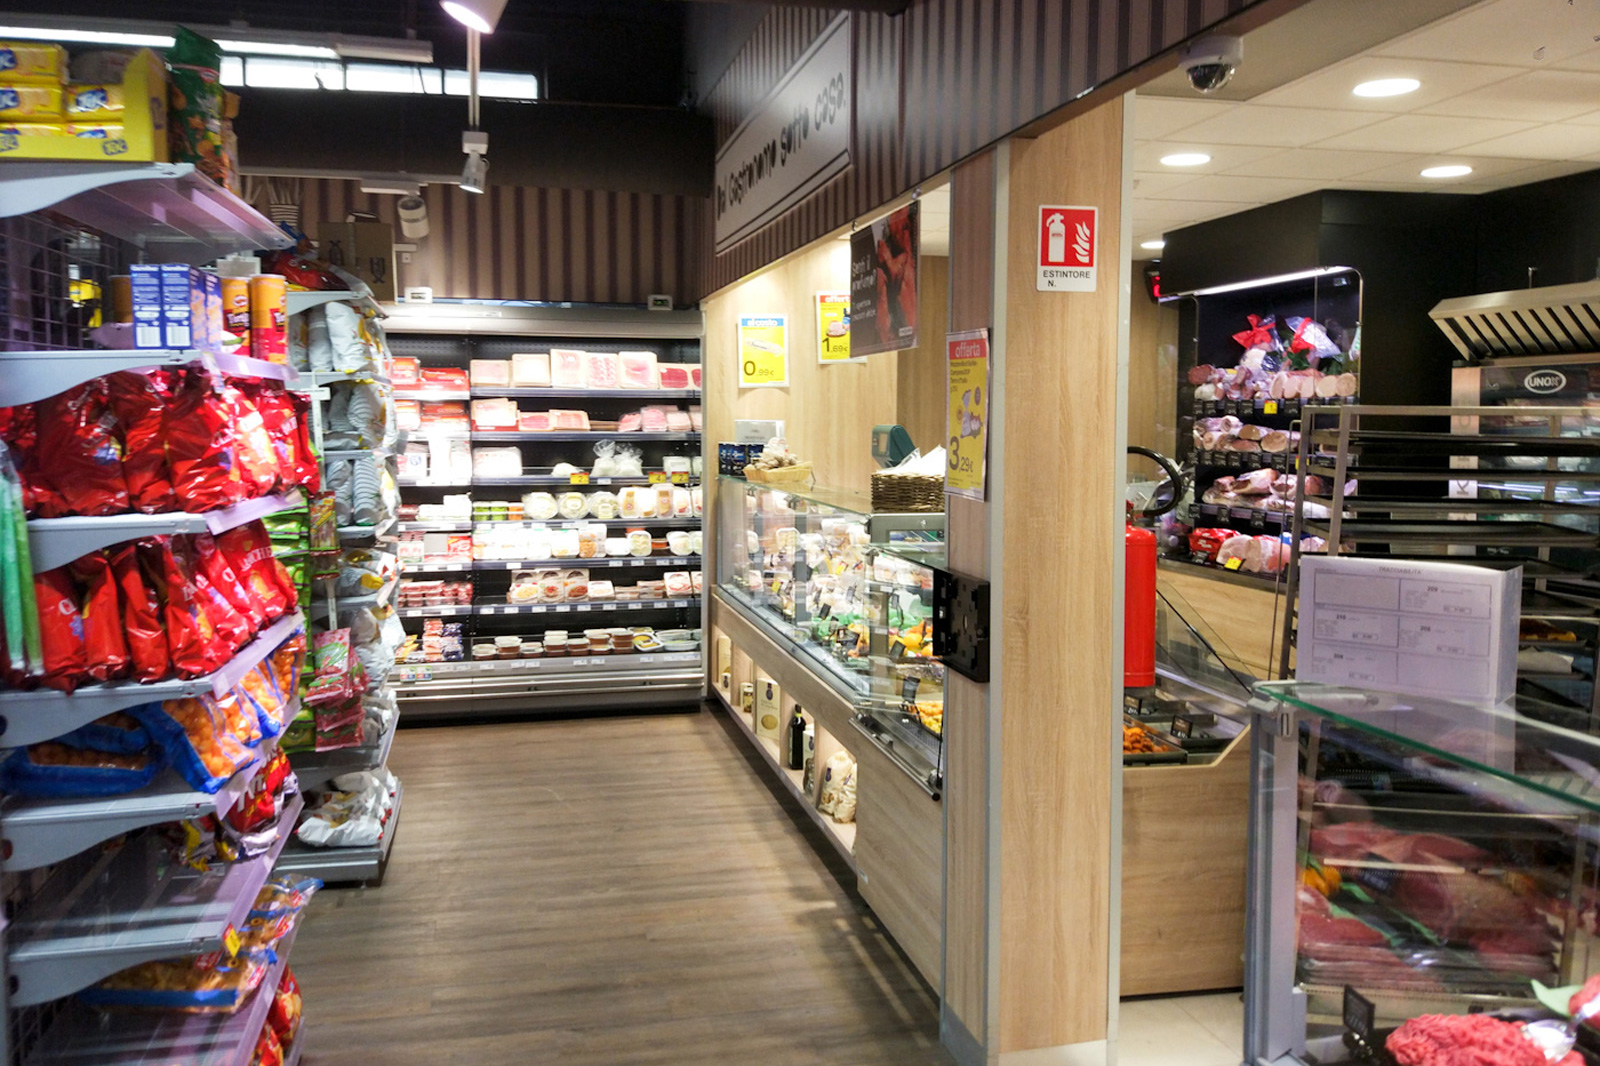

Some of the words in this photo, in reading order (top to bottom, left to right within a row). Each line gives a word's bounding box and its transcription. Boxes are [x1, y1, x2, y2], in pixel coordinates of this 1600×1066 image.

[1043, 270, 1091, 279] ESTINTORE
[1048, 280, 1056, 288] N.
[955, 342, 981, 358] offerta
